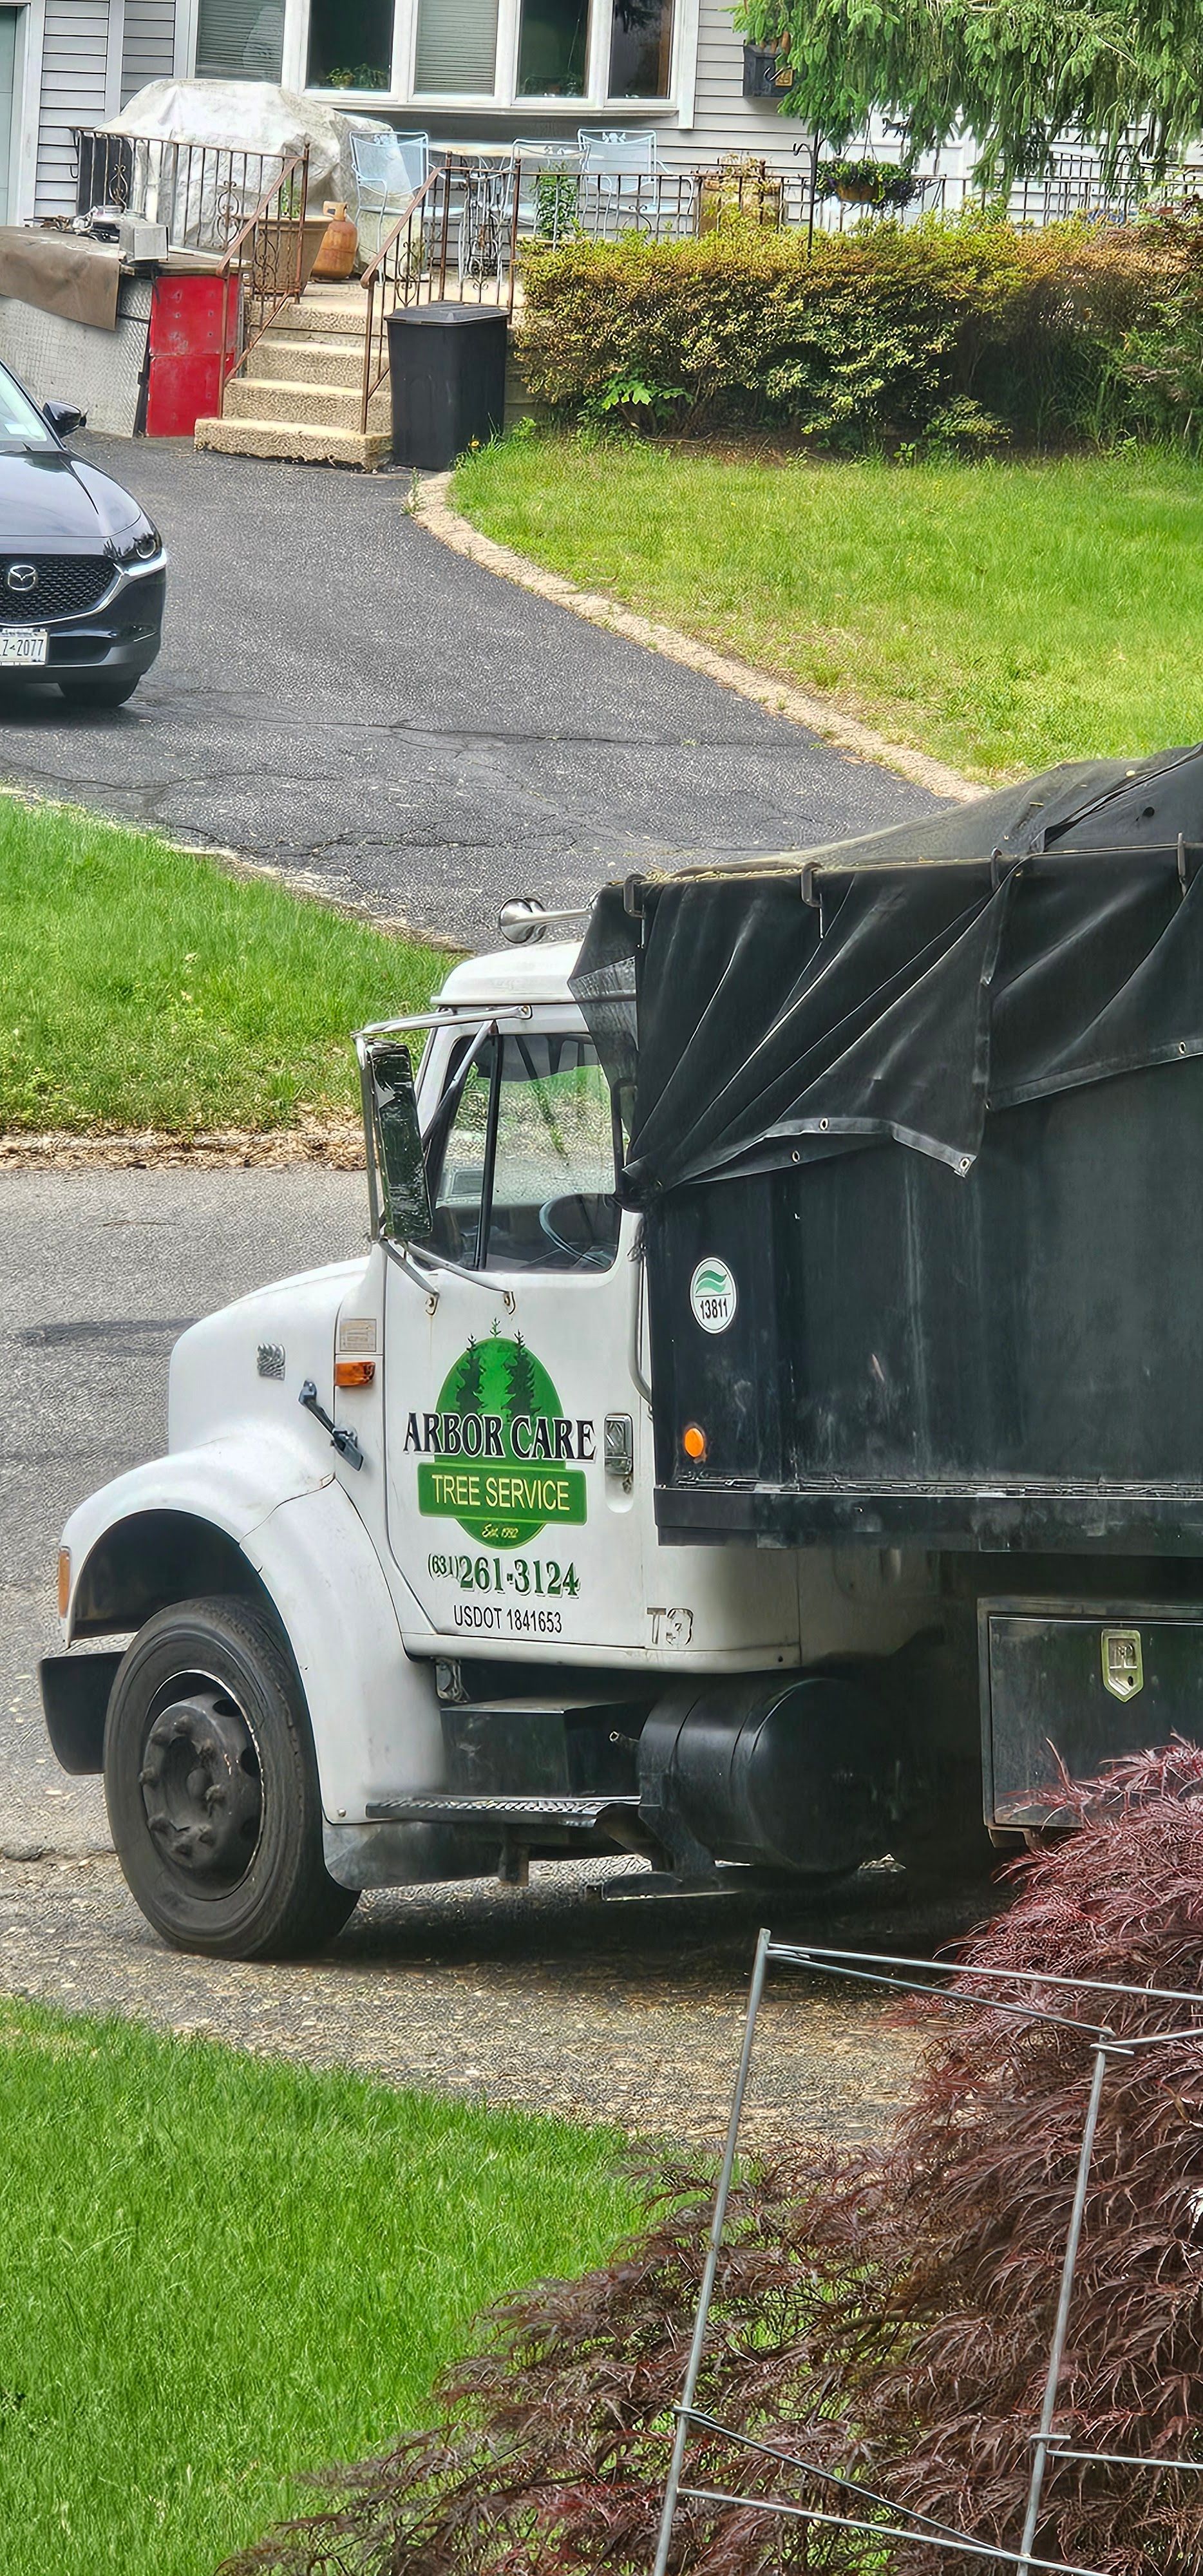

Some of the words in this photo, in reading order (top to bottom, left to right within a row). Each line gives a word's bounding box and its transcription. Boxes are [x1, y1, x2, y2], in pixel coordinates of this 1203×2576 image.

[700, 1297, 728, 1320] 13811
[403, 1412, 506, 1459] ARBOR
[510, 1415, 596, 1463] CARE
[431, 1474, 480, 1506] TREE
[486, 1477, 570, 1511] SERVICE
[454, 1604, 502, 1629] USDOT
[506, 1608, 562, 1633] 1841653
